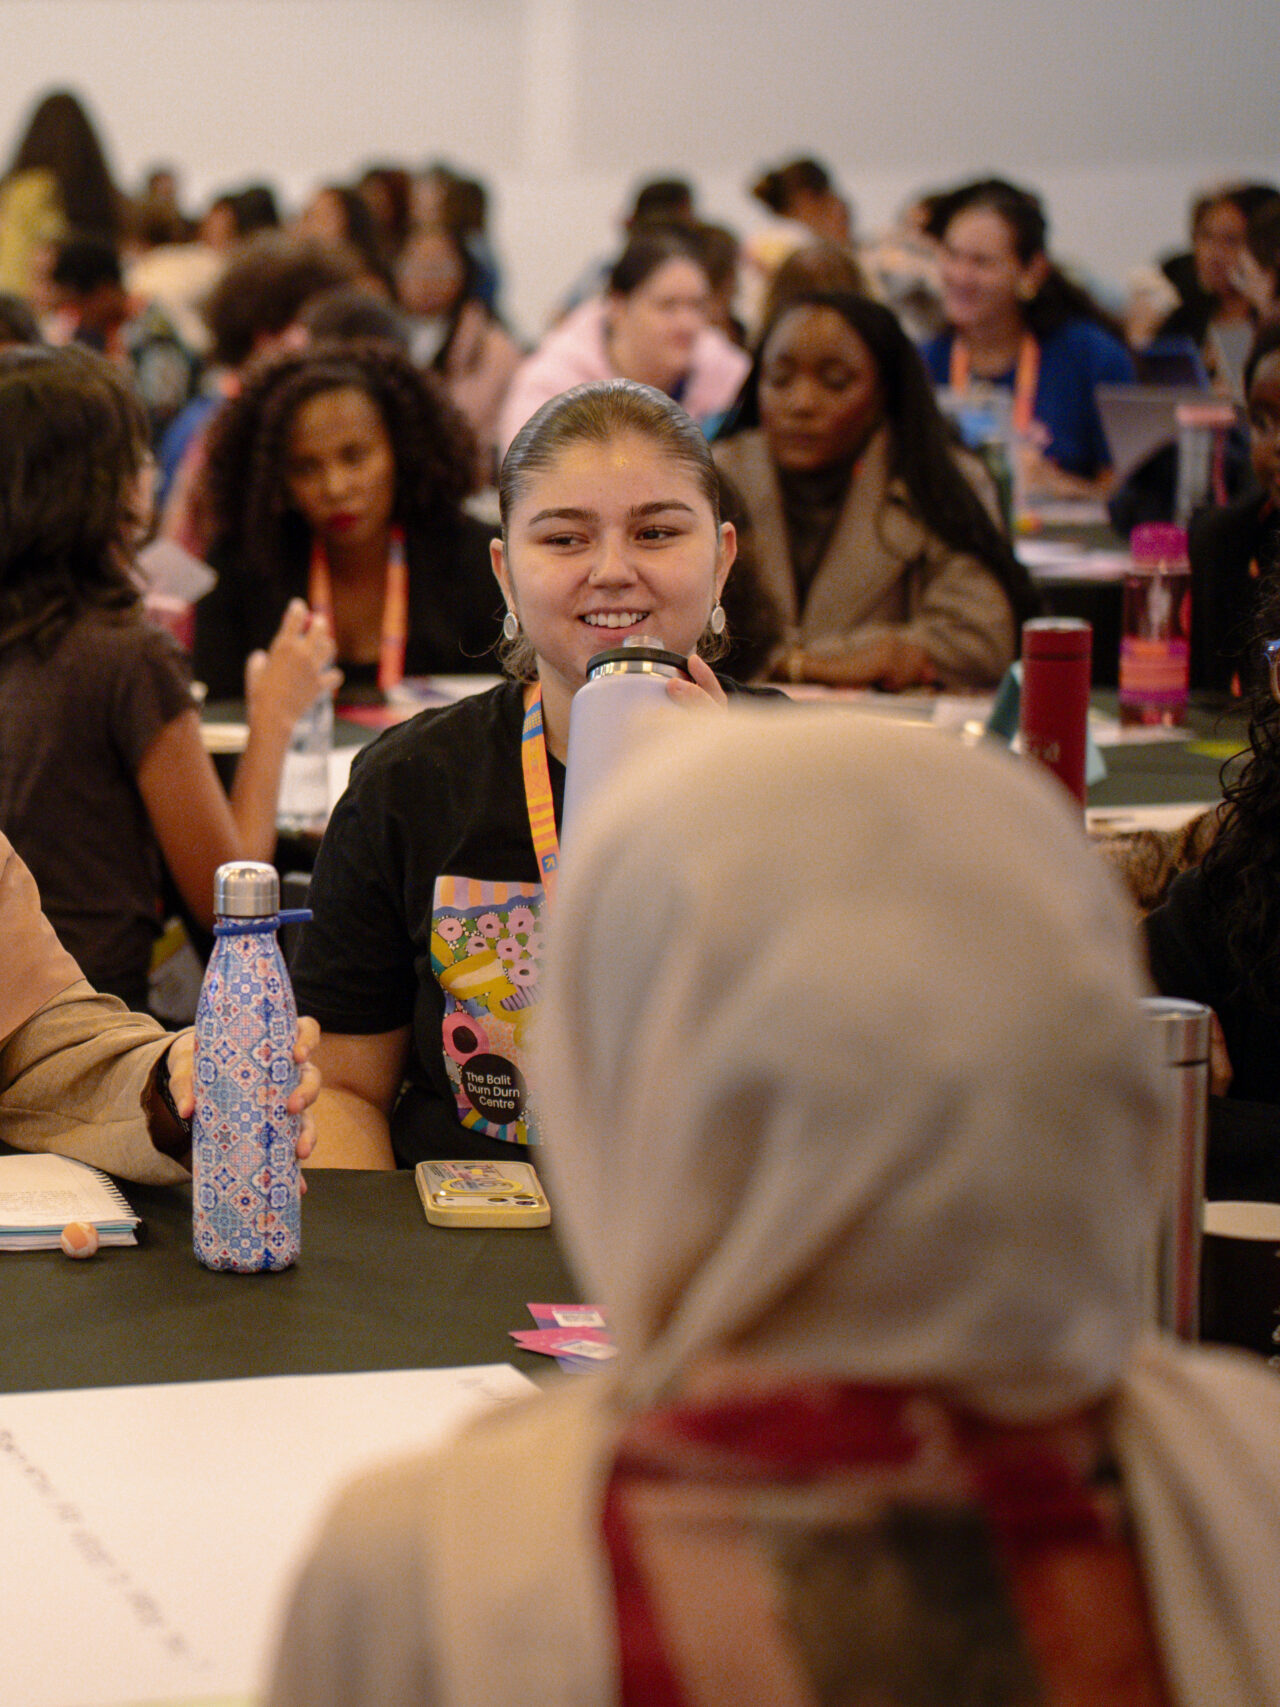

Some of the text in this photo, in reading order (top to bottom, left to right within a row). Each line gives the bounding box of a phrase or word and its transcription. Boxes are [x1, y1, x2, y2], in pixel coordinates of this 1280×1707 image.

[466, 1072, 512, 1085] The Balit
[467, 1082, 520, 1098] Durn Durn
[479, 1096, 515, 1109] Centre
